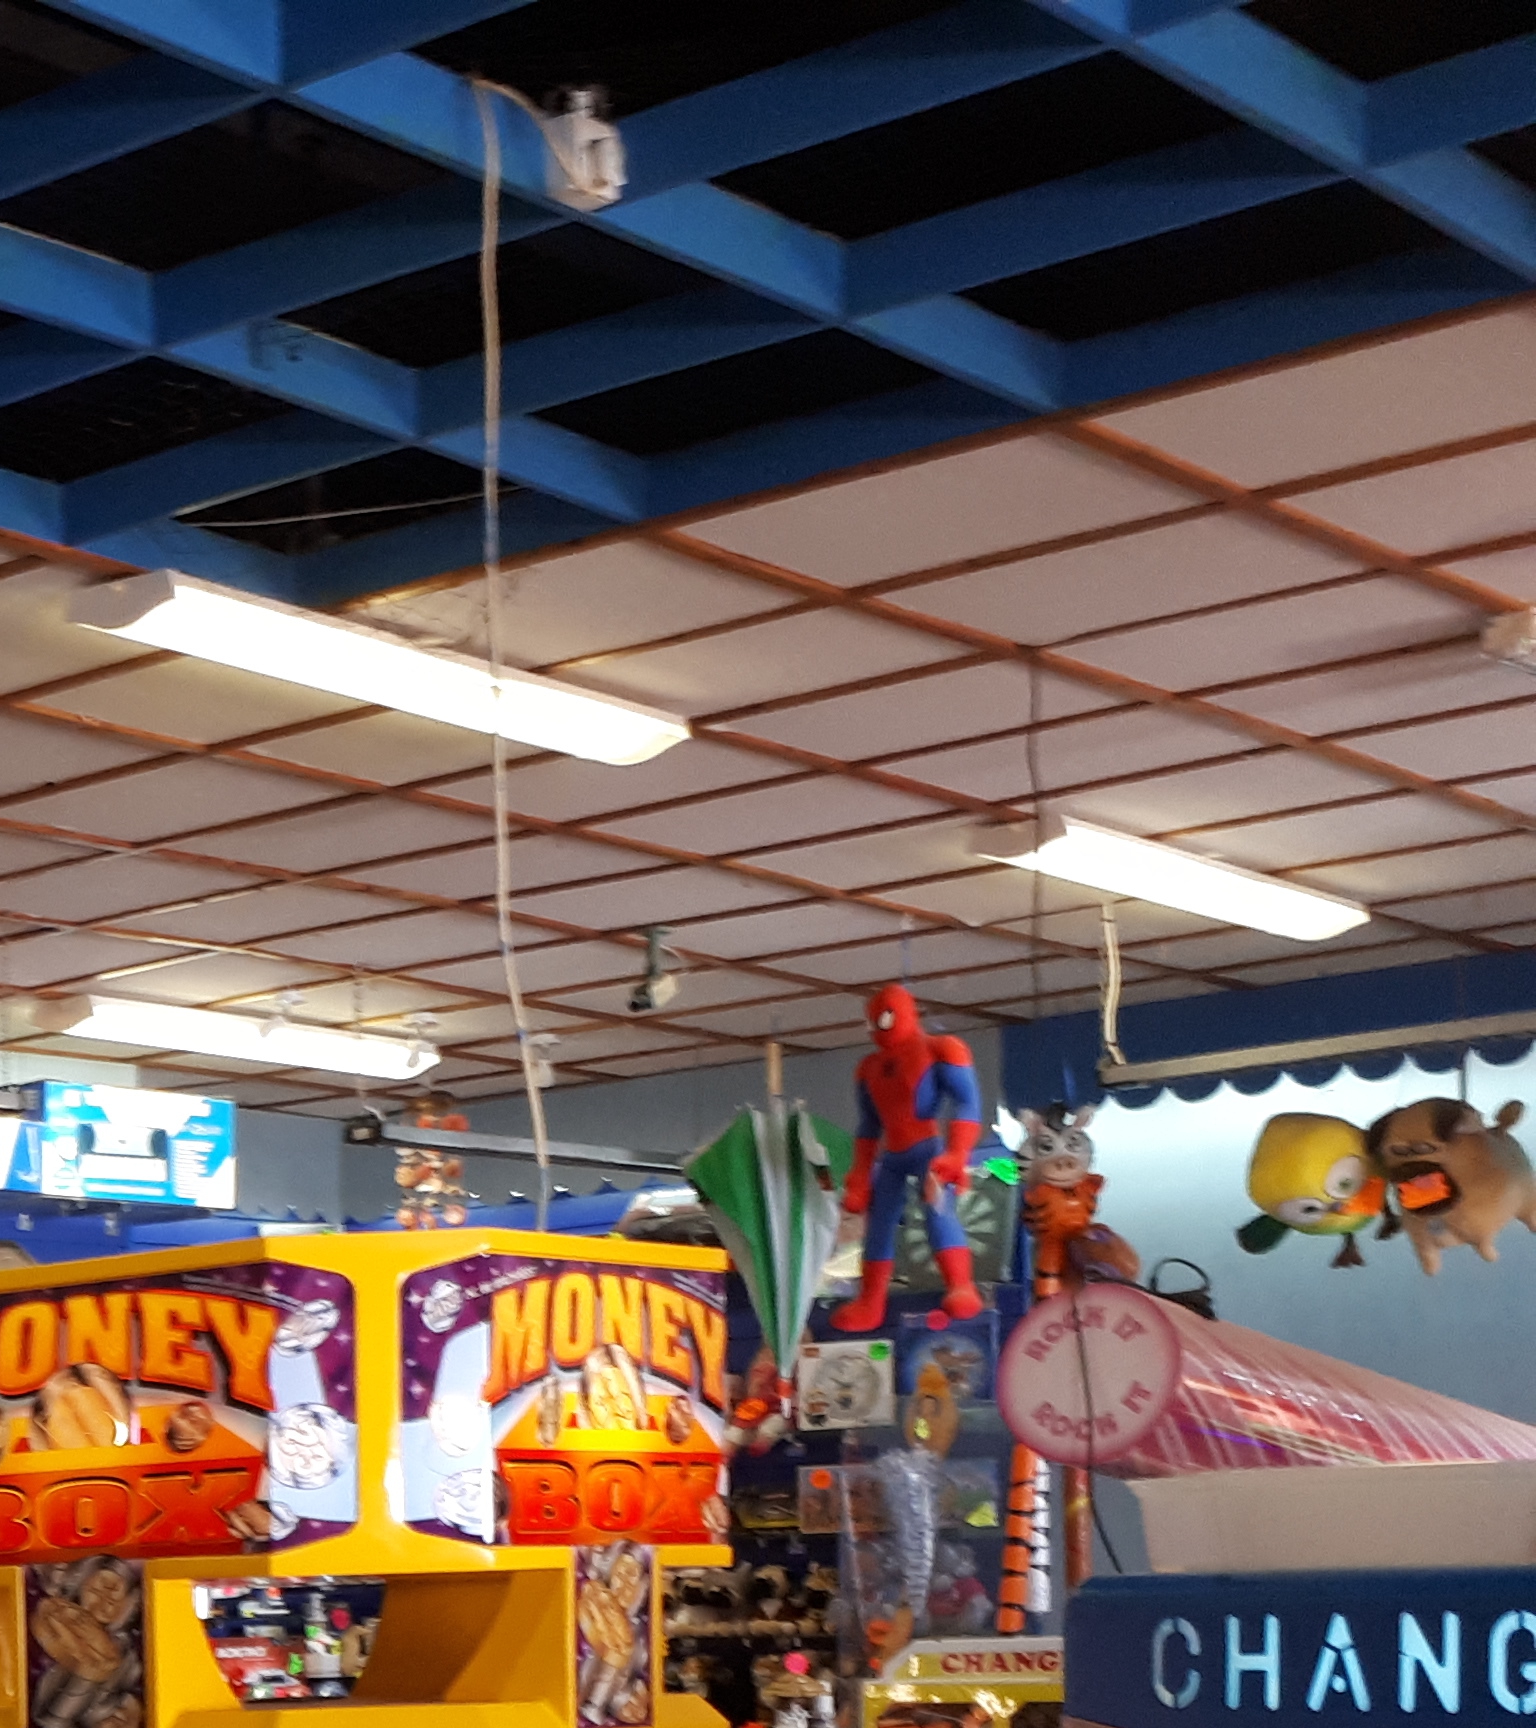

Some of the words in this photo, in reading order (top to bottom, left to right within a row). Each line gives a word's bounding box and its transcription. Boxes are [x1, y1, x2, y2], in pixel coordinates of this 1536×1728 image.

[482, 1271, 726, 1406] MONEY
[501, 1458, 720, 1534] BOX
[940, 1651, 1059, 1675] CHANG
[1151, 1609, 1536, 1716] CHANG
